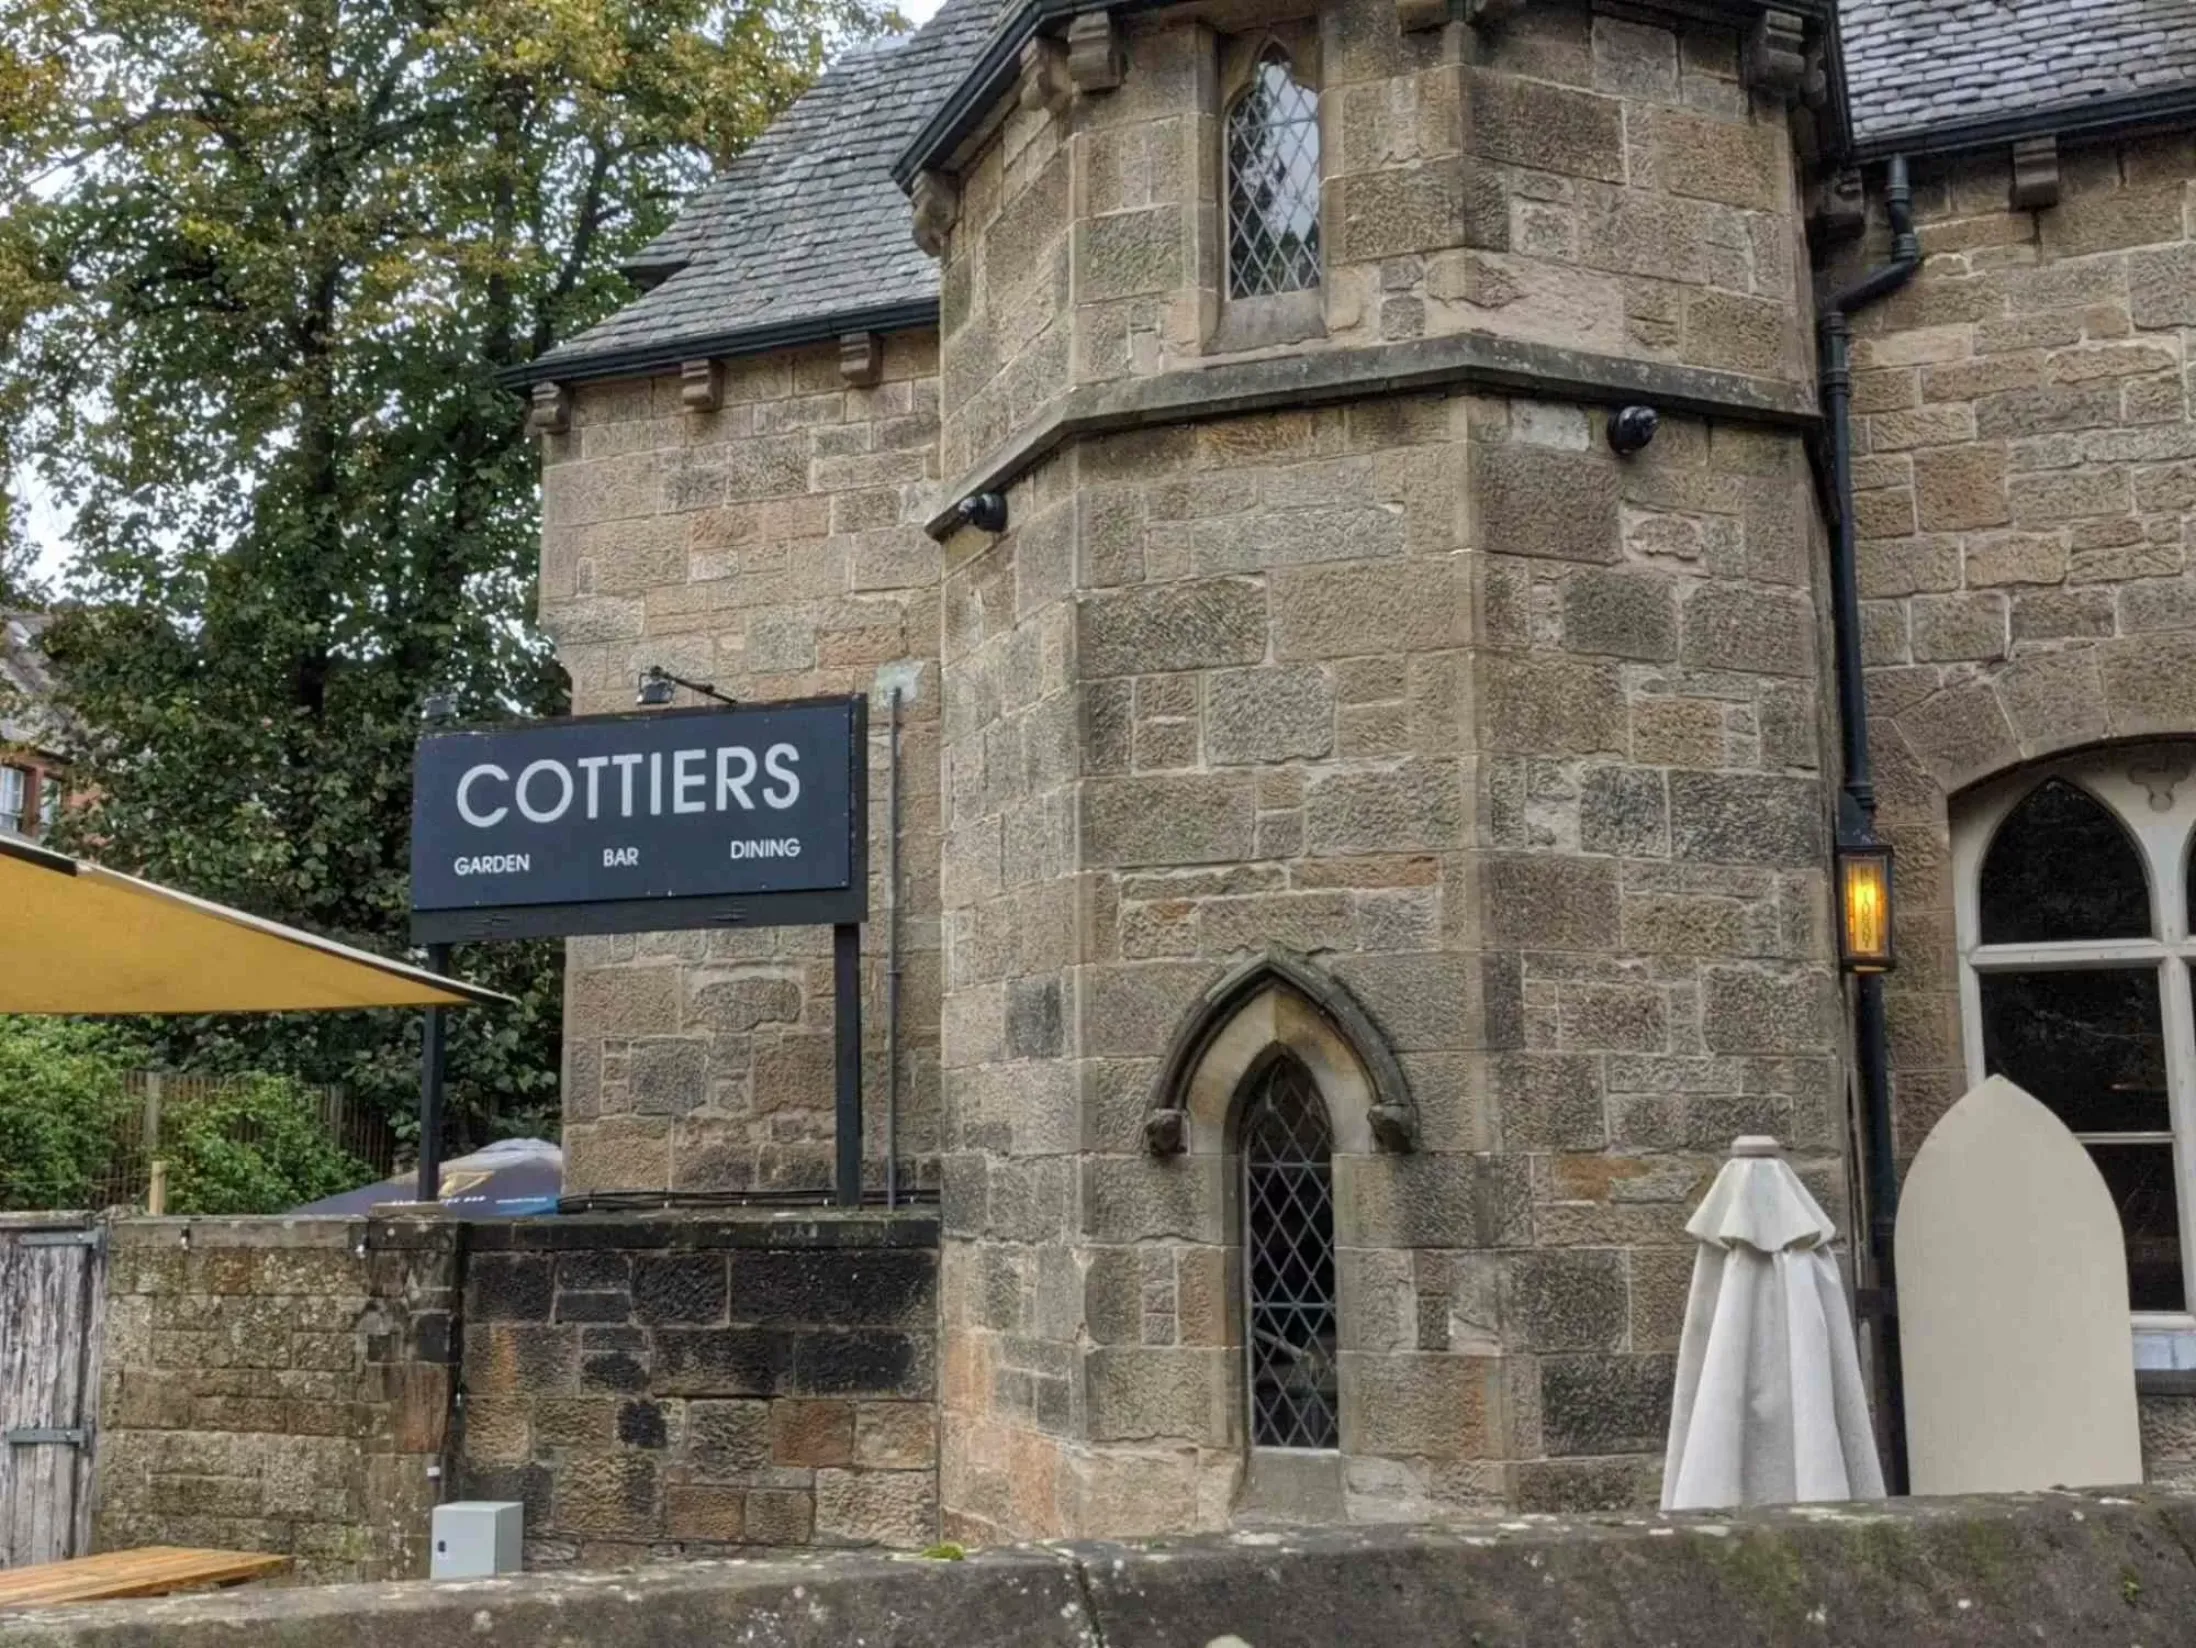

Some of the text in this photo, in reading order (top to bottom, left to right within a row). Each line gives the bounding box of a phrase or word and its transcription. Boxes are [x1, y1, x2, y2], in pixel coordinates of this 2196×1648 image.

[456, 742, 800, 828] COTTIERS
[454, 837, 801, 876] GARDEN BAR DINING
